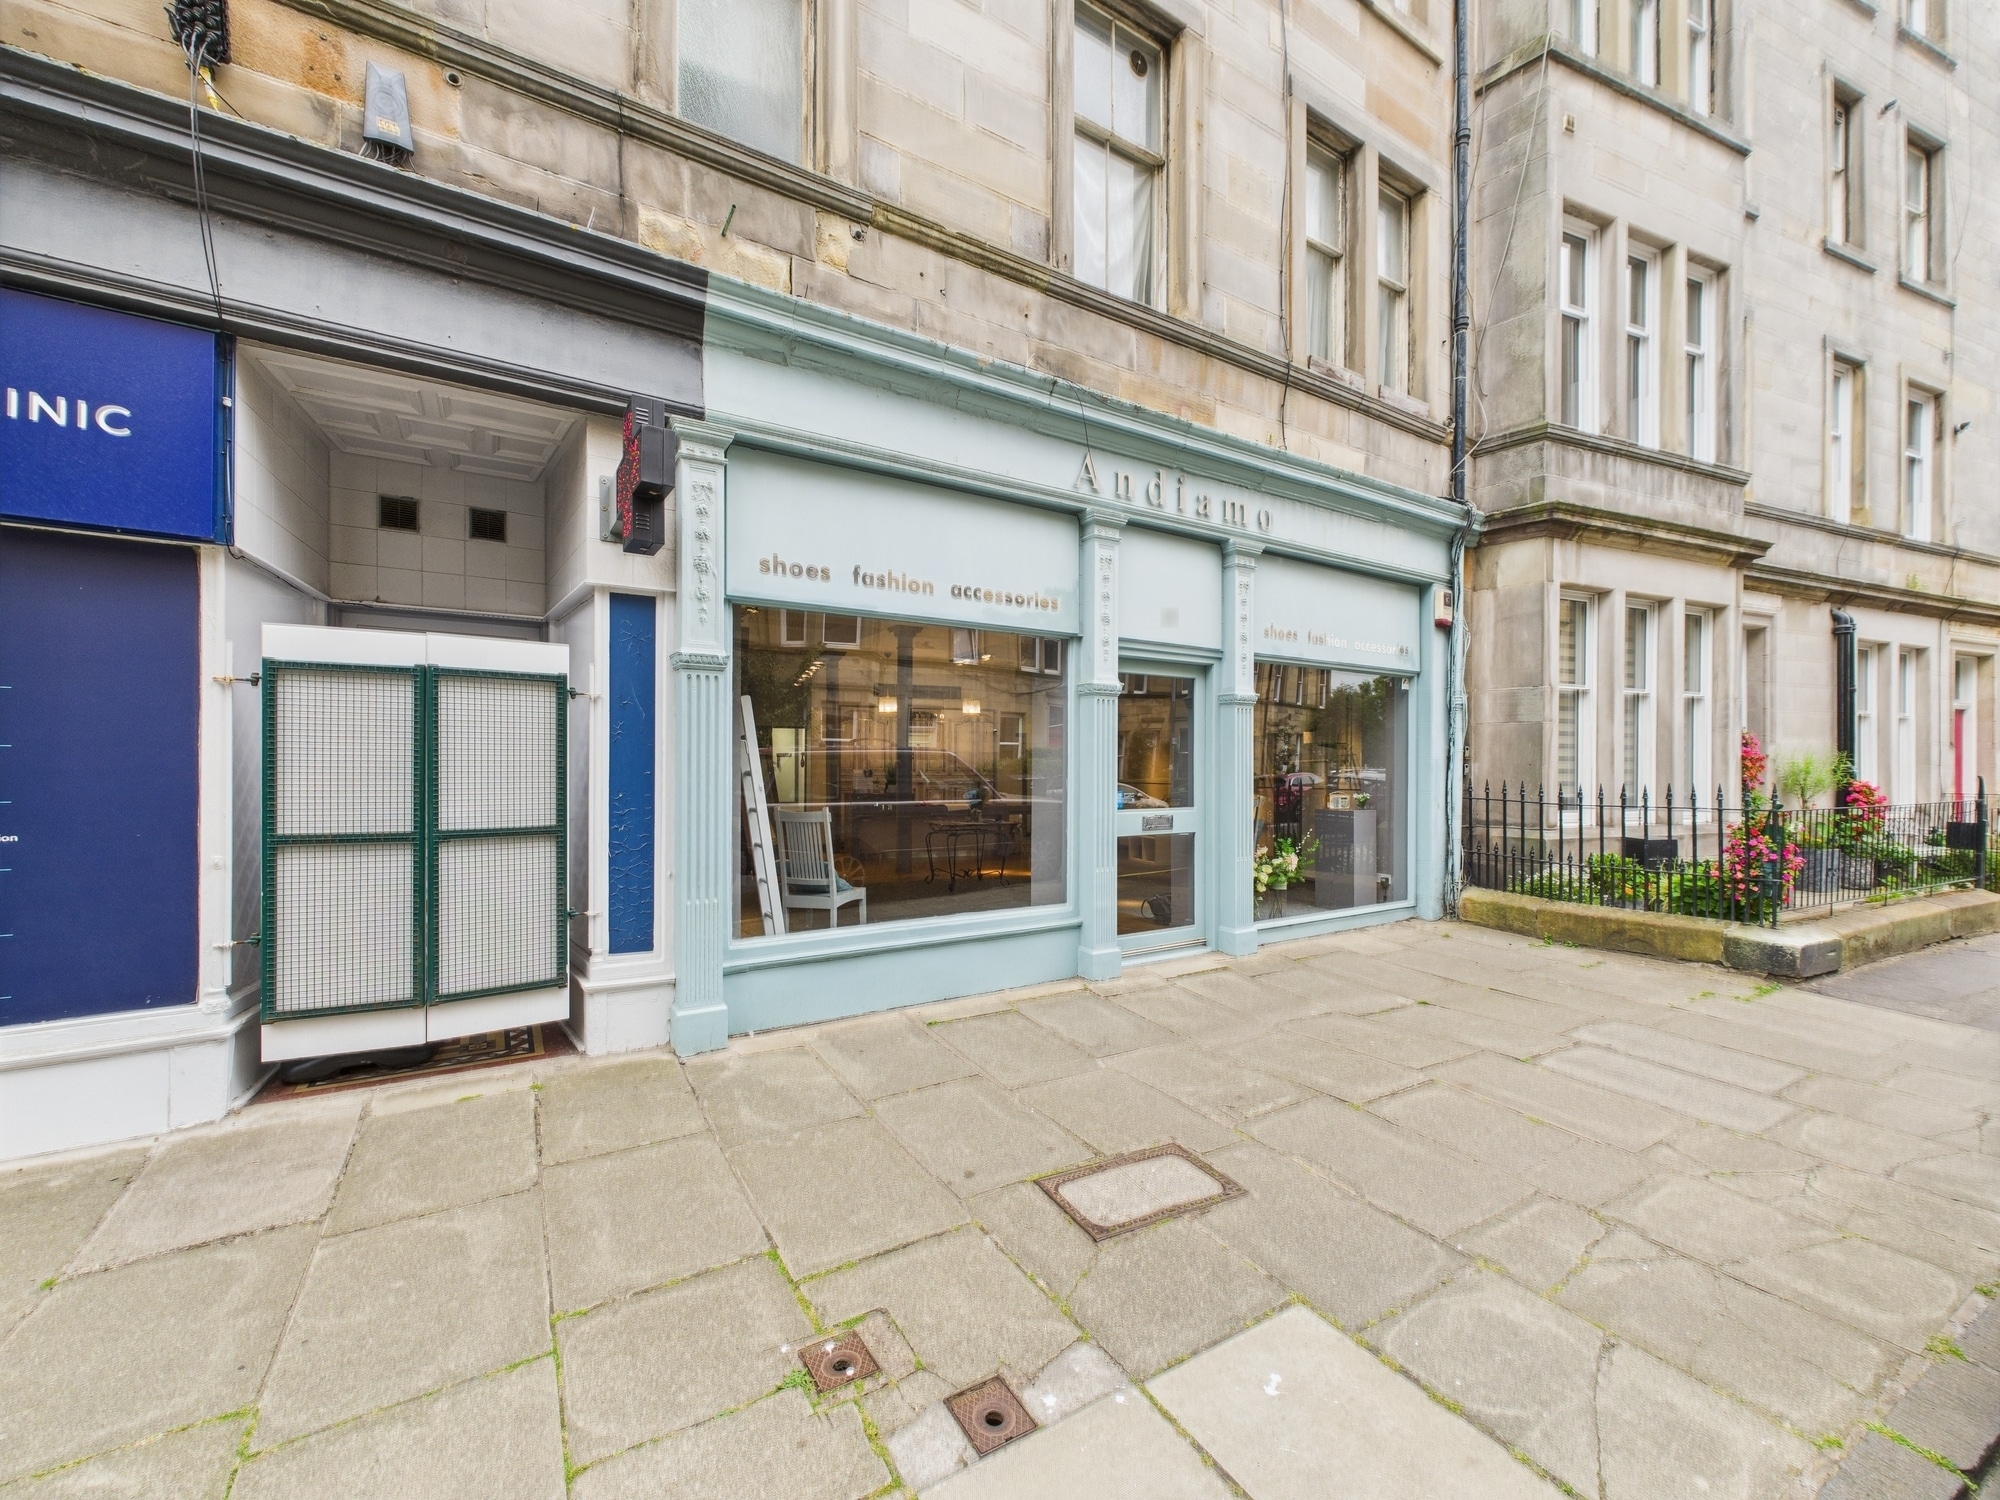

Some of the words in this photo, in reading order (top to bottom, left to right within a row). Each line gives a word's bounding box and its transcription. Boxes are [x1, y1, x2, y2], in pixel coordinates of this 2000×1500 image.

[7, 387, 132, 437] INIC
[1074, 451, 1273, 531] Andiamo
[759, 552, 831, 581] shoes
[852, 564, 934, 595] fashion
[950, 582, 1060, 612] accessories
[1263, 622, 1298, 642] shoes
[1307, 630, 1348, 649] fashion
[1354, 639, 1410, 657] accessories
